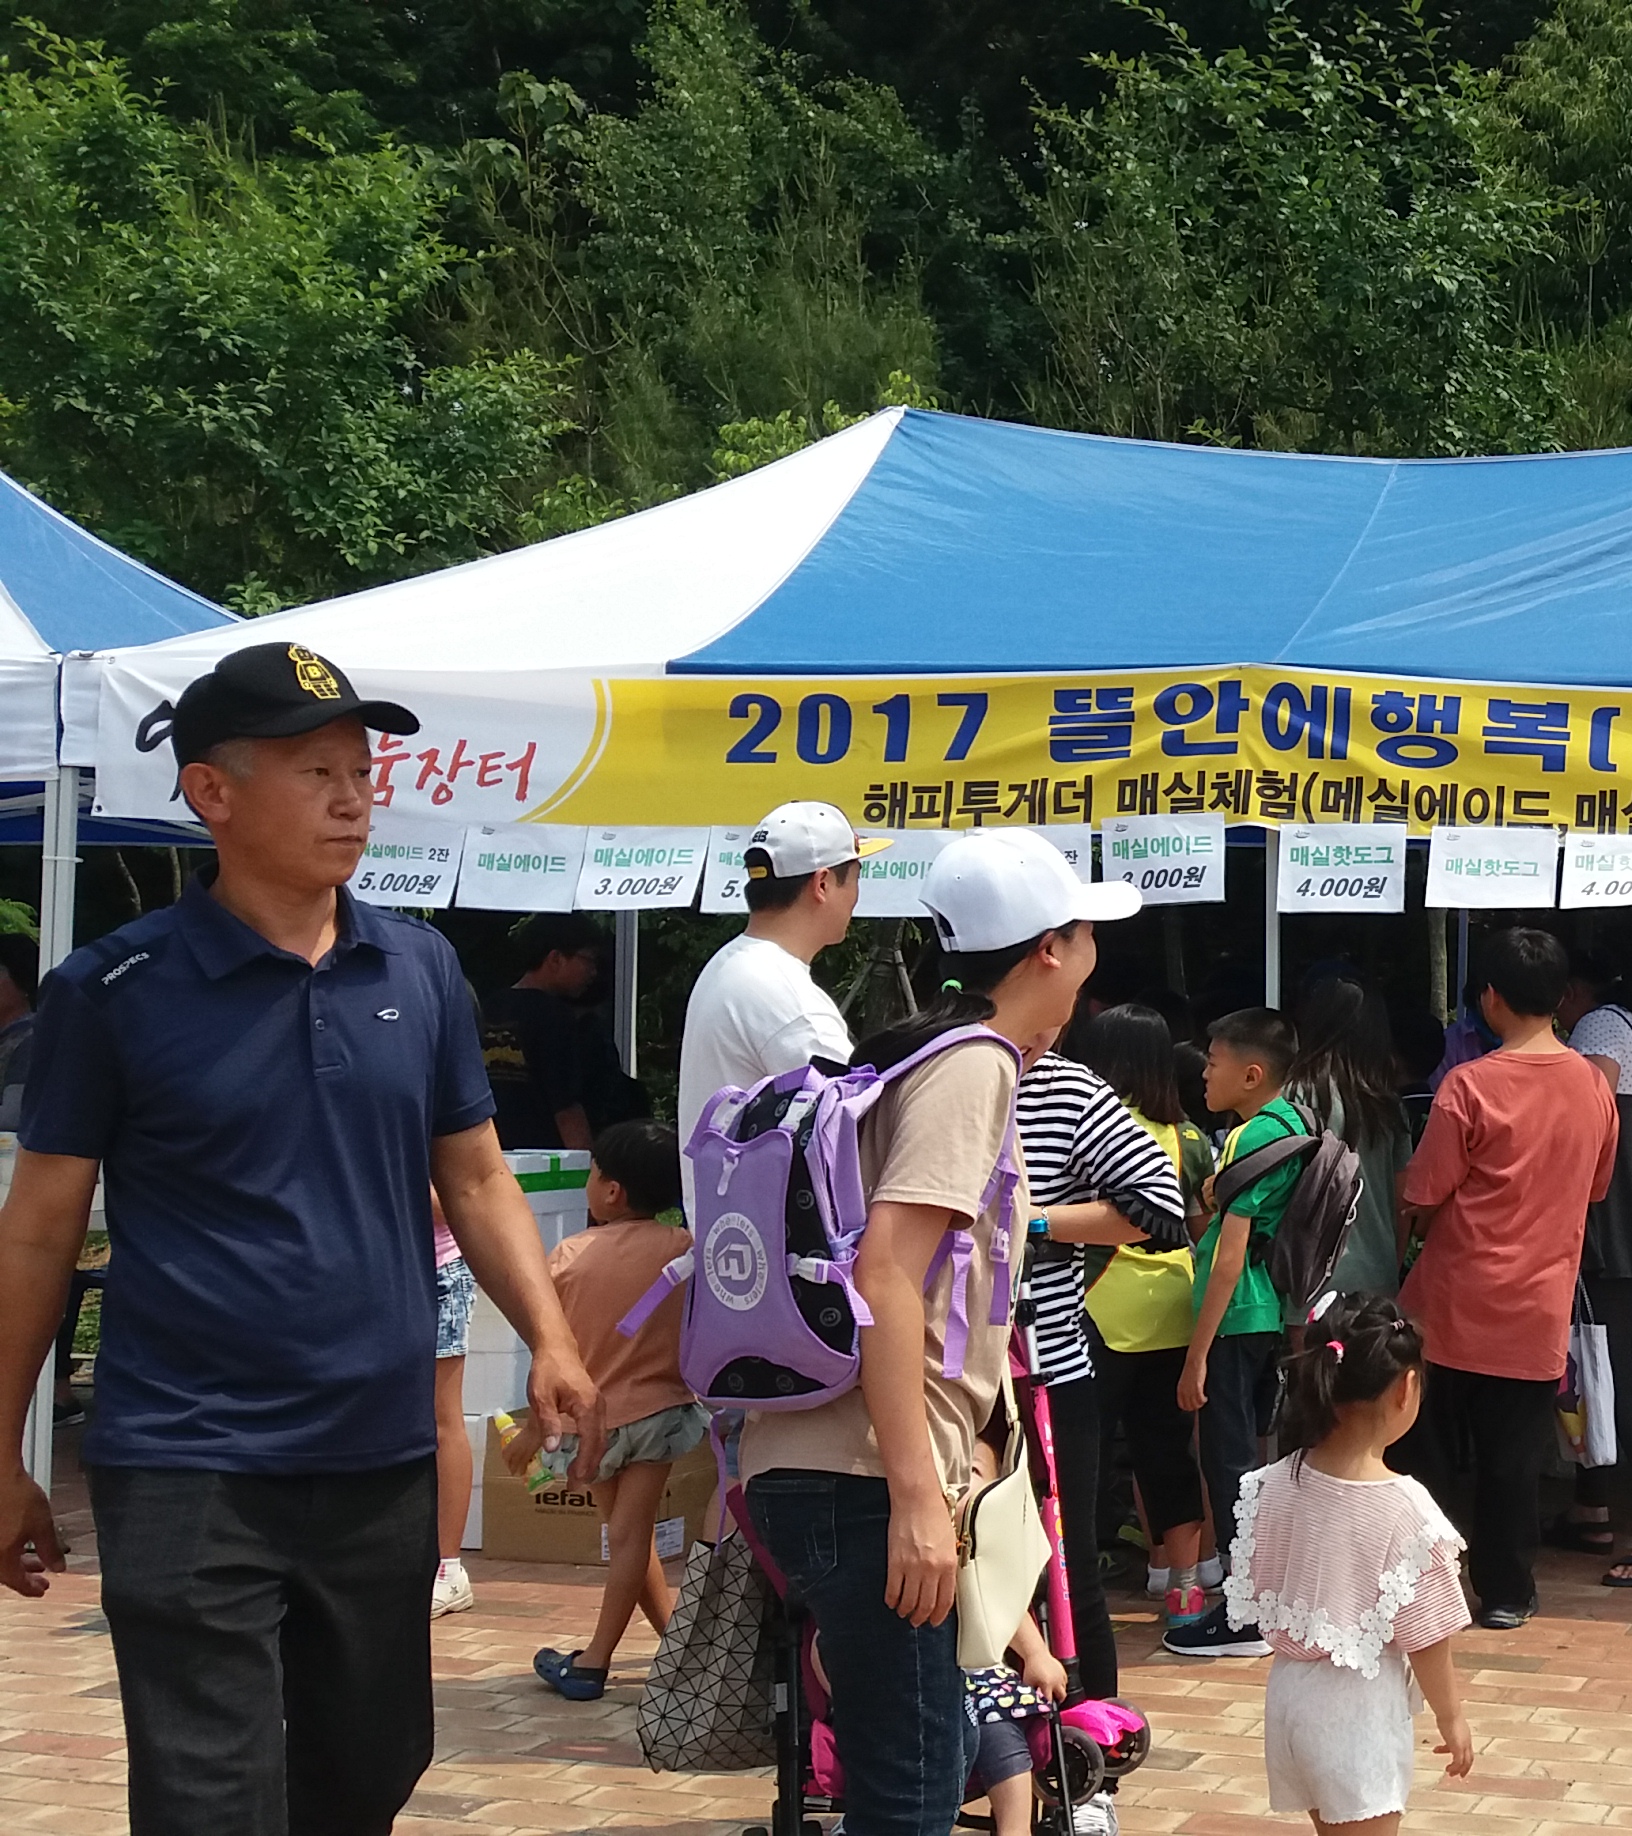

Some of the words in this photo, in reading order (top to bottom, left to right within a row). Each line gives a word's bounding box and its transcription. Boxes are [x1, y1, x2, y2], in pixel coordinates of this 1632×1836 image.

[725, 692, 989, 765] 2017
[371, 732, 537, 808] 눔장터
[862, 775, 1093, 829] 해피투게더
[428, 847, 450, 862] 2잔
[593, 846, 695, 868] 매실에이드
[1111, 833, 1214, 861] 매실에이드
[1287, 841, 1395, 869] 매실핫도그
[477, 852, 567, 874] 매실에이드
[1443, 856, 1541, 878] 매실핫도그
[358, 871, 442, 895] 5.000원
[593, 875, 684, 898] 3.000원
[1295, 875, 1388, 901] 4.000원
[101, 951, 150, 986] PROSPECS
